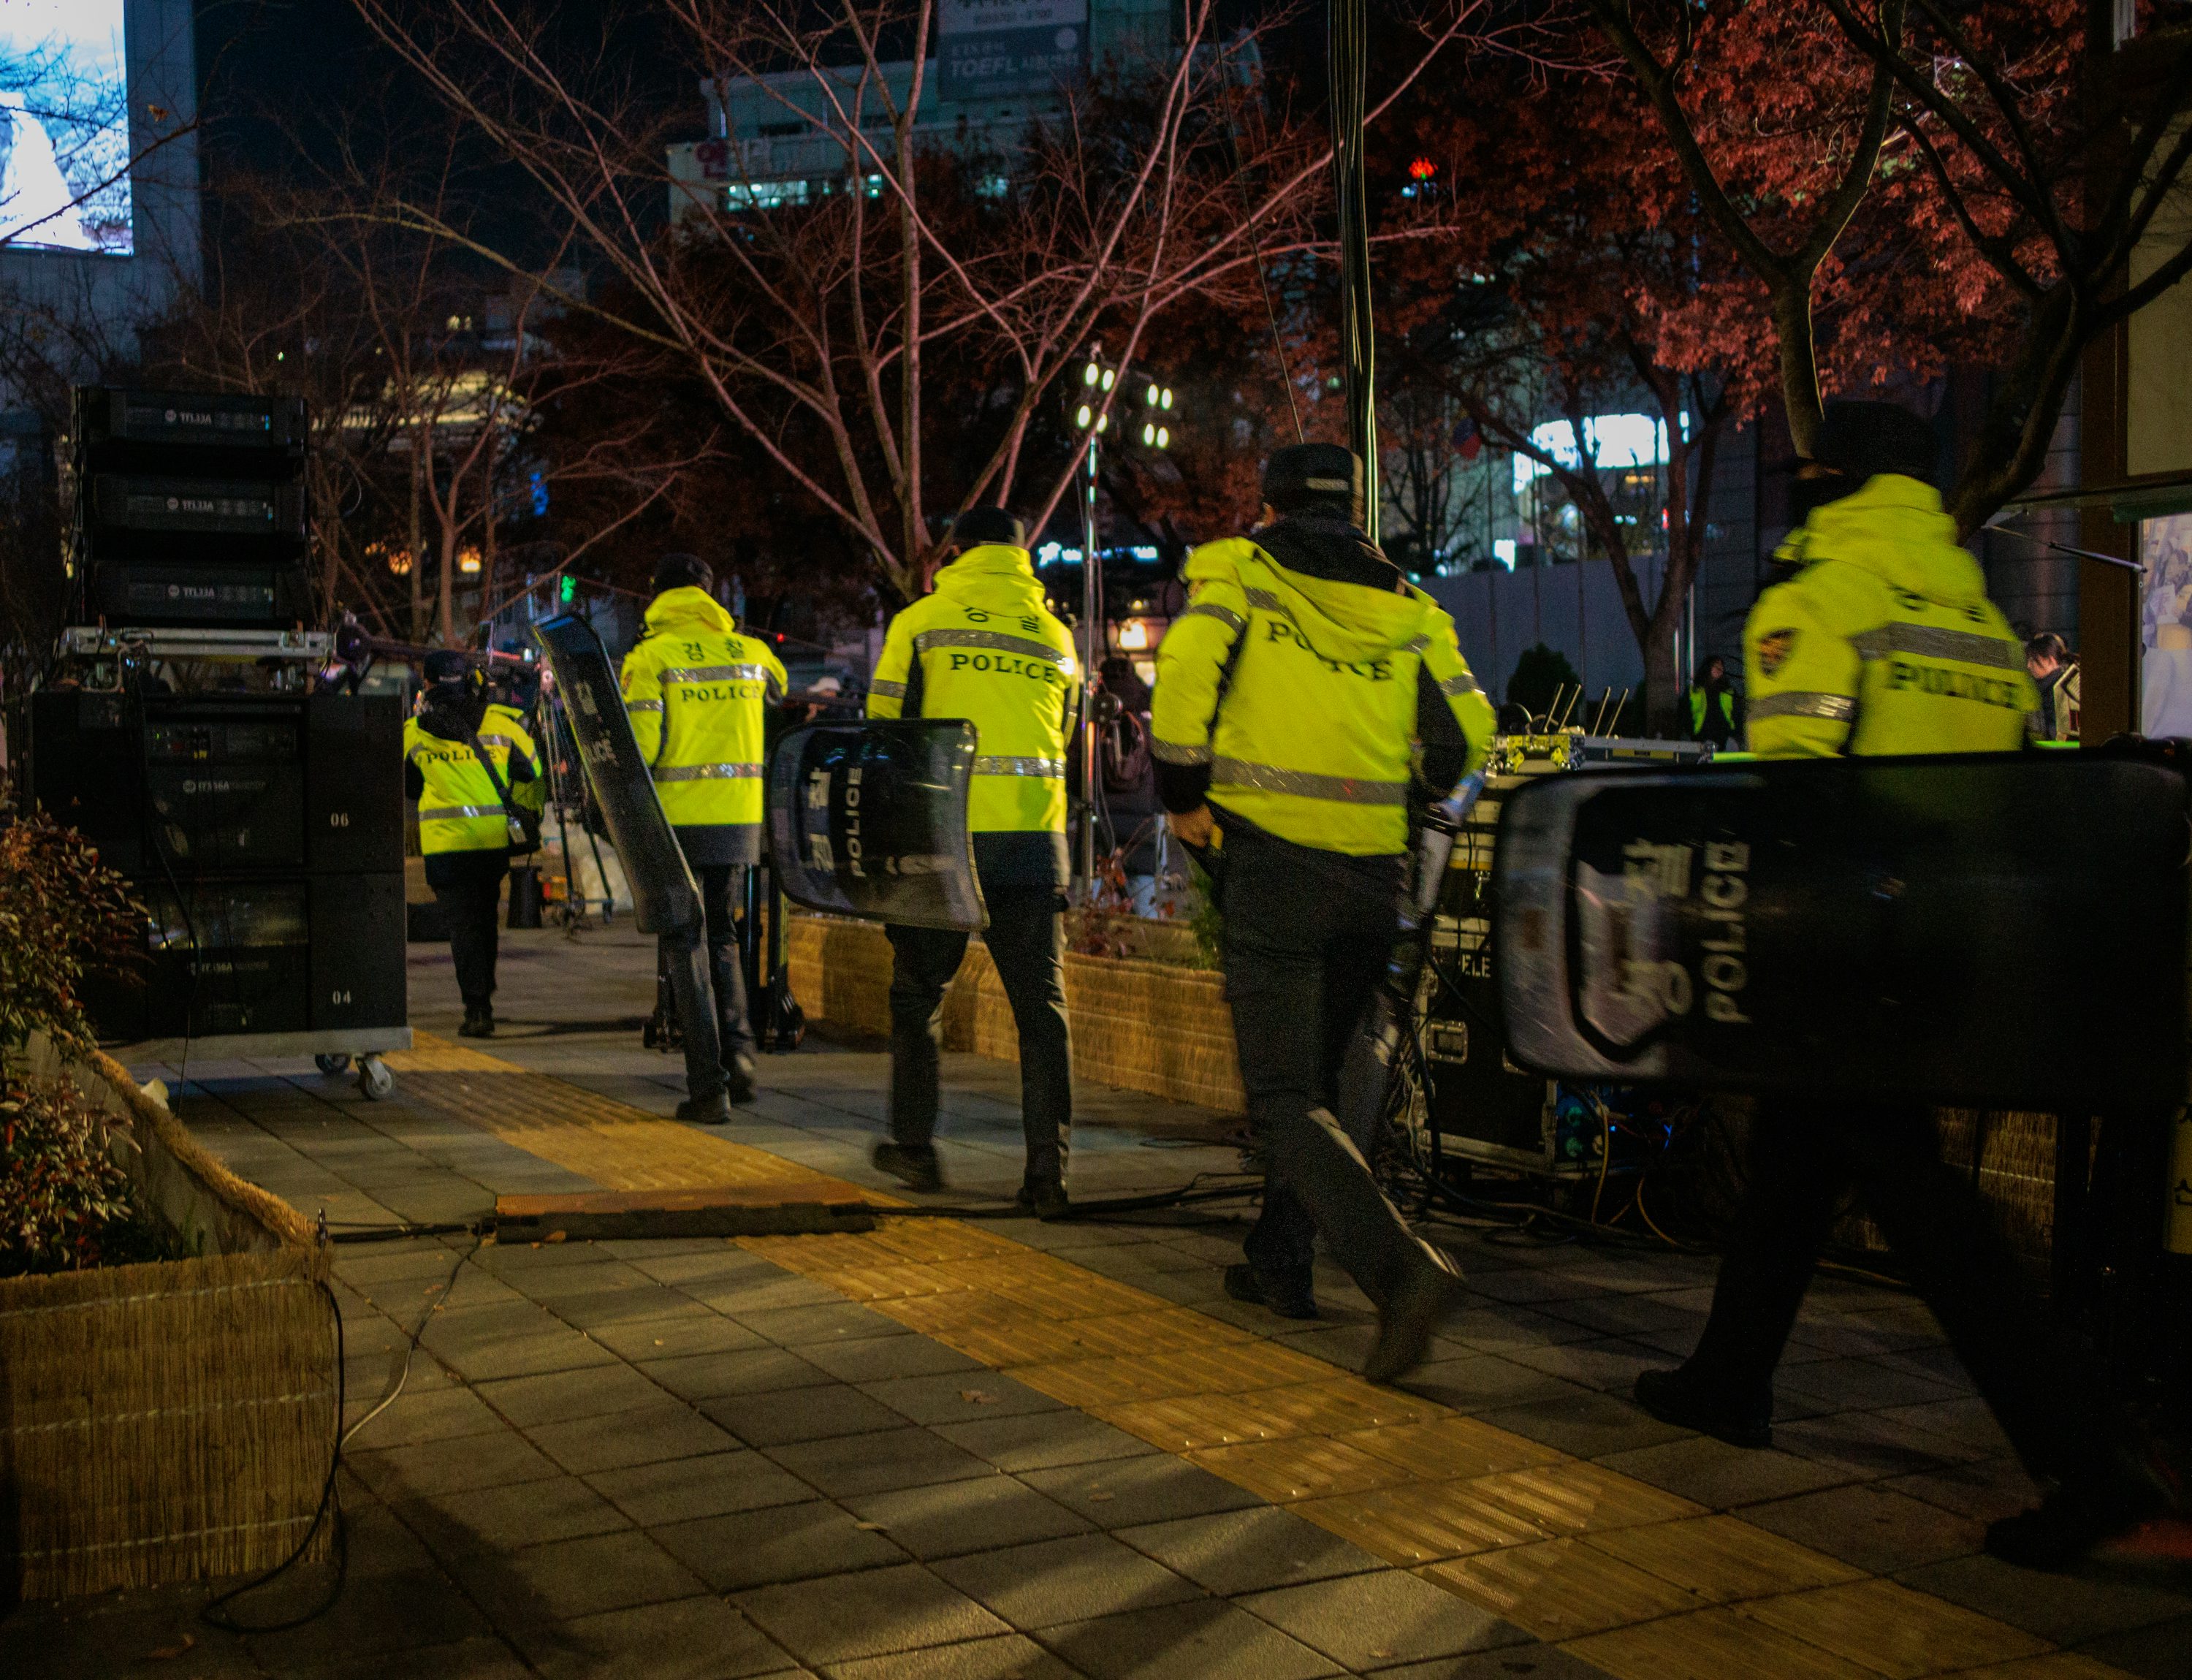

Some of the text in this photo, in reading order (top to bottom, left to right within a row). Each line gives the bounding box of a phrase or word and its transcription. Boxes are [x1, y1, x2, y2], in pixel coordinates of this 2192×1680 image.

[951, 56, 1019, 77] TOEFL
[950, 654, 1058, 683] POLICE
[681, 685, 761, 702] POLICE
[845, 767, 867, 877] POLICE
[1700, 840, 1753, 1023] POLICE
[332, 989, 351, 1006] 04
